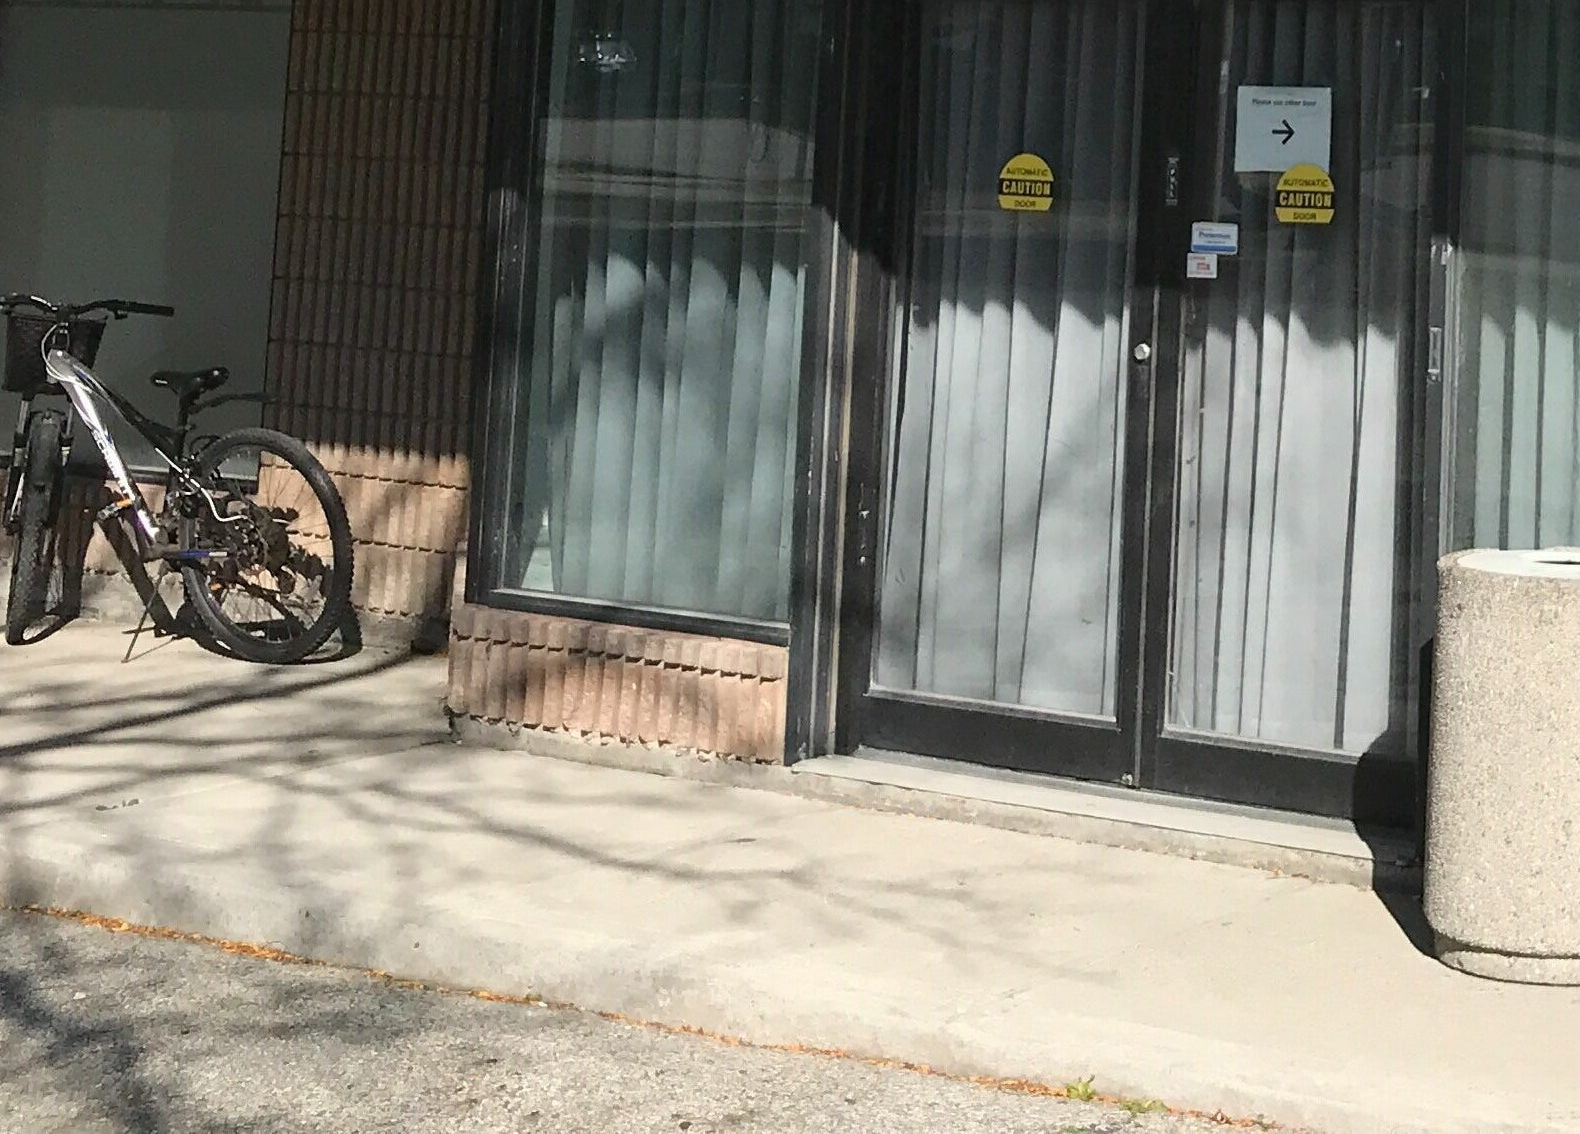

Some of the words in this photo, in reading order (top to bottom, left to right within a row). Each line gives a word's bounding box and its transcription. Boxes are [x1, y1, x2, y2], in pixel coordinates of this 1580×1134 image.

[1006, 167, 1049, 177] AUTOMATIC
[1283, 178, 1329, 188] AUTOMATIC
[1002, 181, 1051, 196] CAUTION
[1279, 192, 1332, 207] CAUTION
[1292, 212, 1317, 220] DOOR
